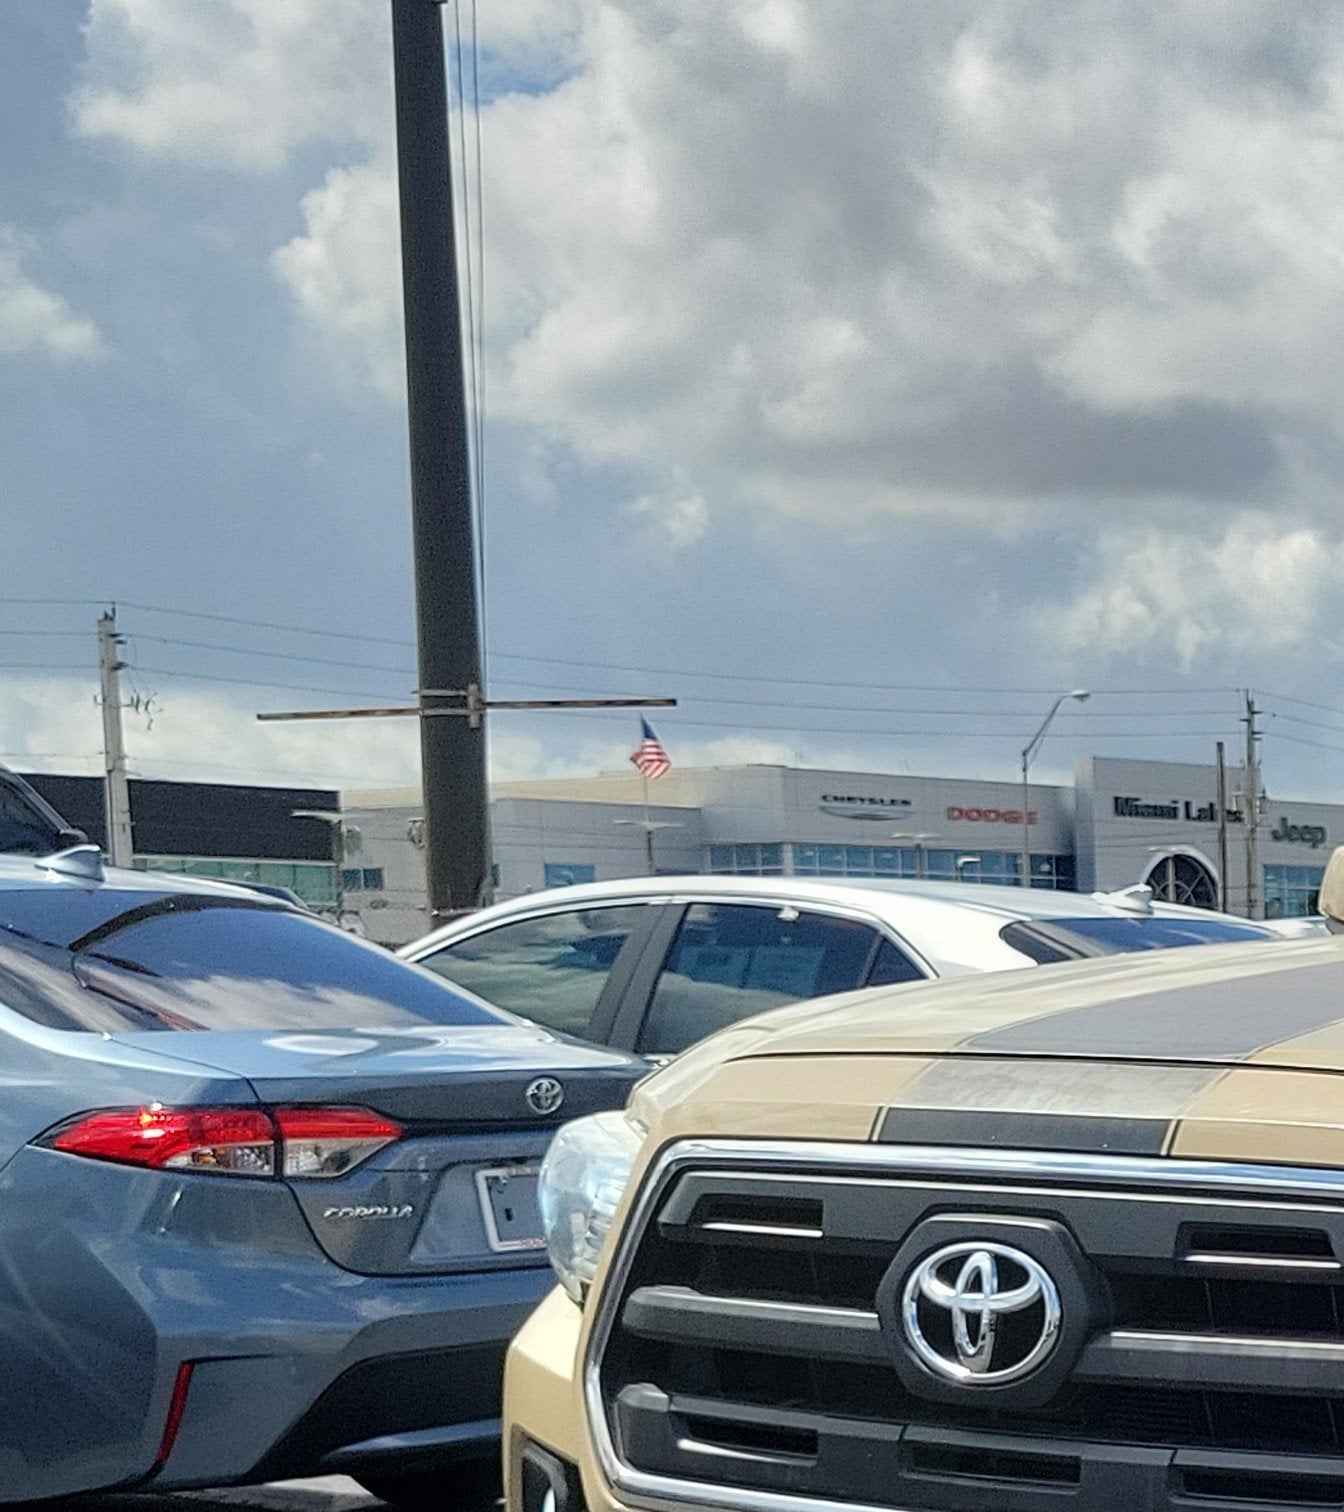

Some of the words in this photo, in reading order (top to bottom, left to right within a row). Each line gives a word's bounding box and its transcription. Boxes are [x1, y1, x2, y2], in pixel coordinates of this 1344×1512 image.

[947, 806, 1038, 825] DODGE
[1113, 796, 1180, 819] Miami
[1271, 817, 1327, 849] Jeep
[323, 1204, 414, 1220] COROLLA
